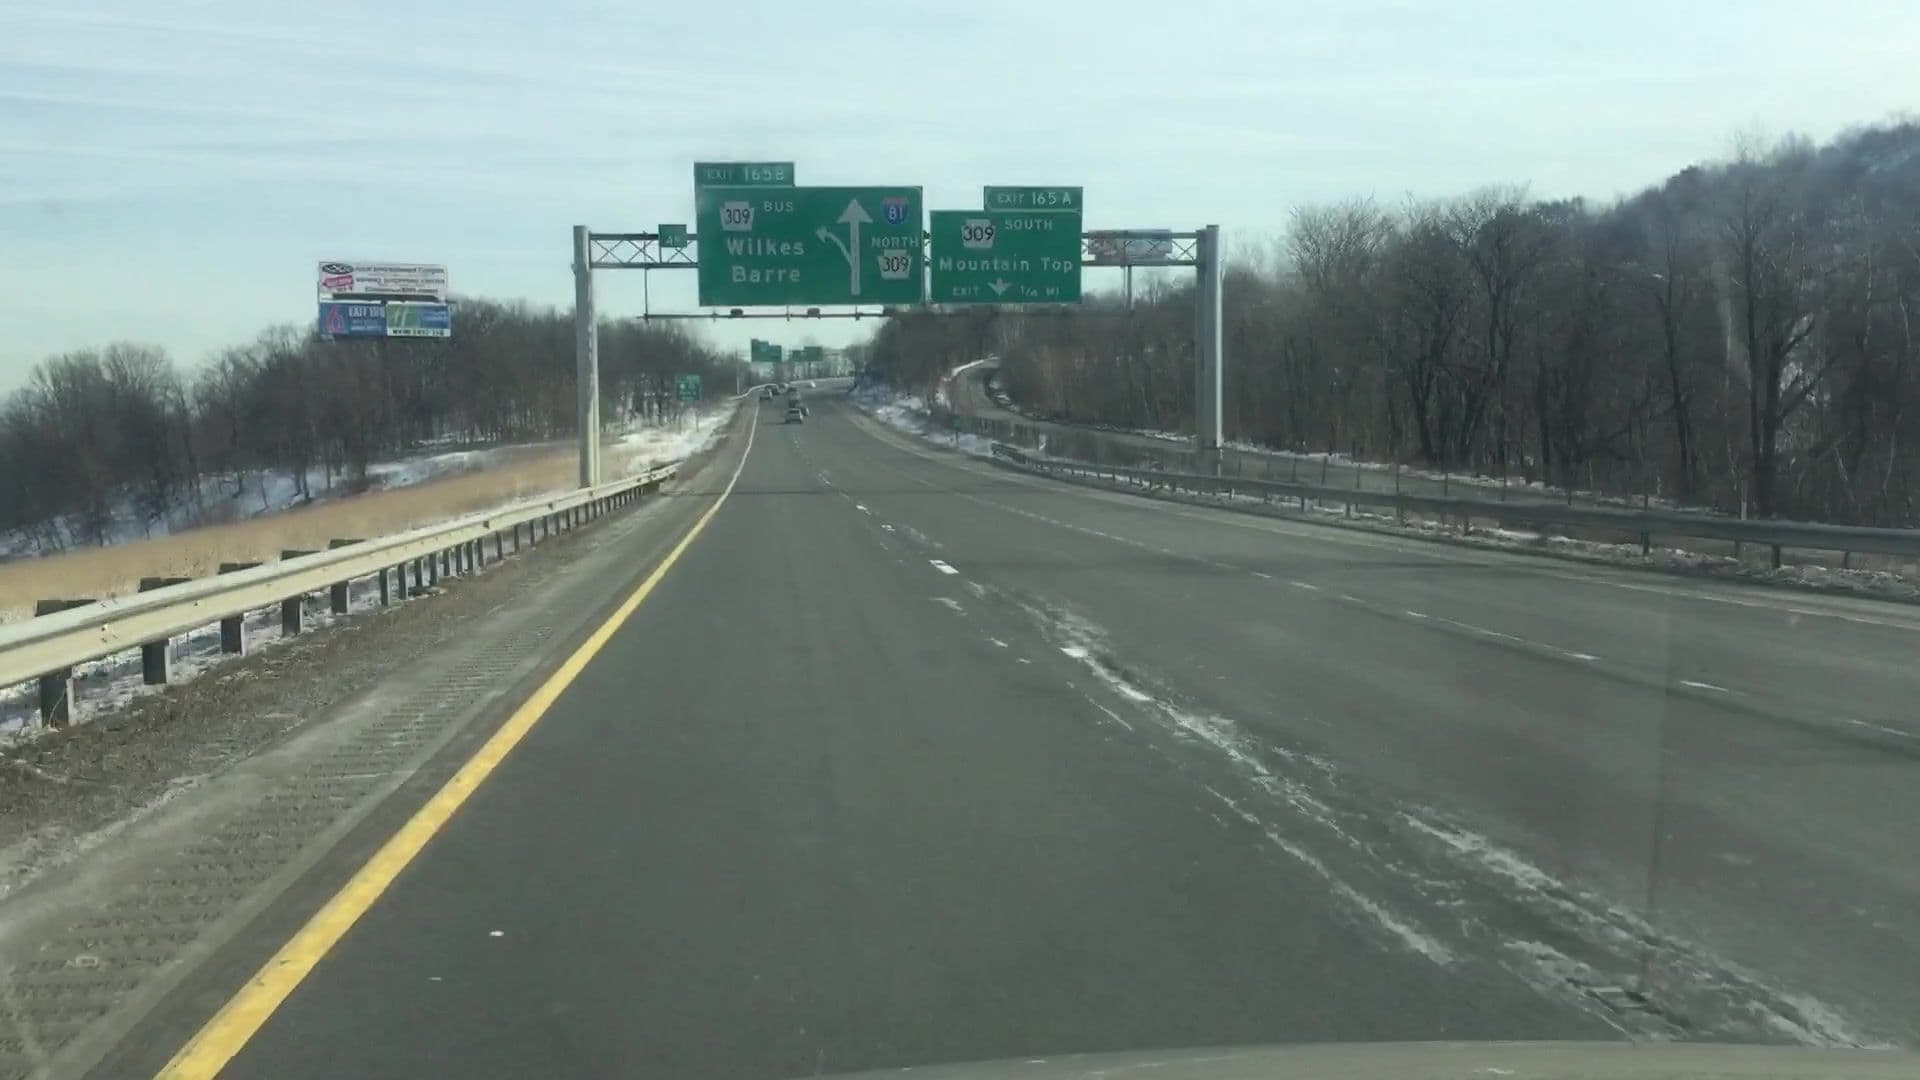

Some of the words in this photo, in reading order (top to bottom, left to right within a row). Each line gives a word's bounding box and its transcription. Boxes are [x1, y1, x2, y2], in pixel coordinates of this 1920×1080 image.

[744, 167, 785, 181] 165B
[998, 192, 1024, 203] EXIT
[764, 201, 794, 213] BUS
[888, 206, 904, 220] 81
[725, 207, 751, 225] 309
[1004, 219, 1053, 231] SOUTH
[963, 226, 994, 241] 309
[727, 237, 805, 256] Wilkes
[871, 236, 919, 248] NORTH
[882, 255, 909, 272] 309
[939, 254, 1030, 272] Mountain
[1041, 256, 1073, 274] Top
[731, 265, 801, 283] Barre
[952, 286, 979, 296] EXIT
